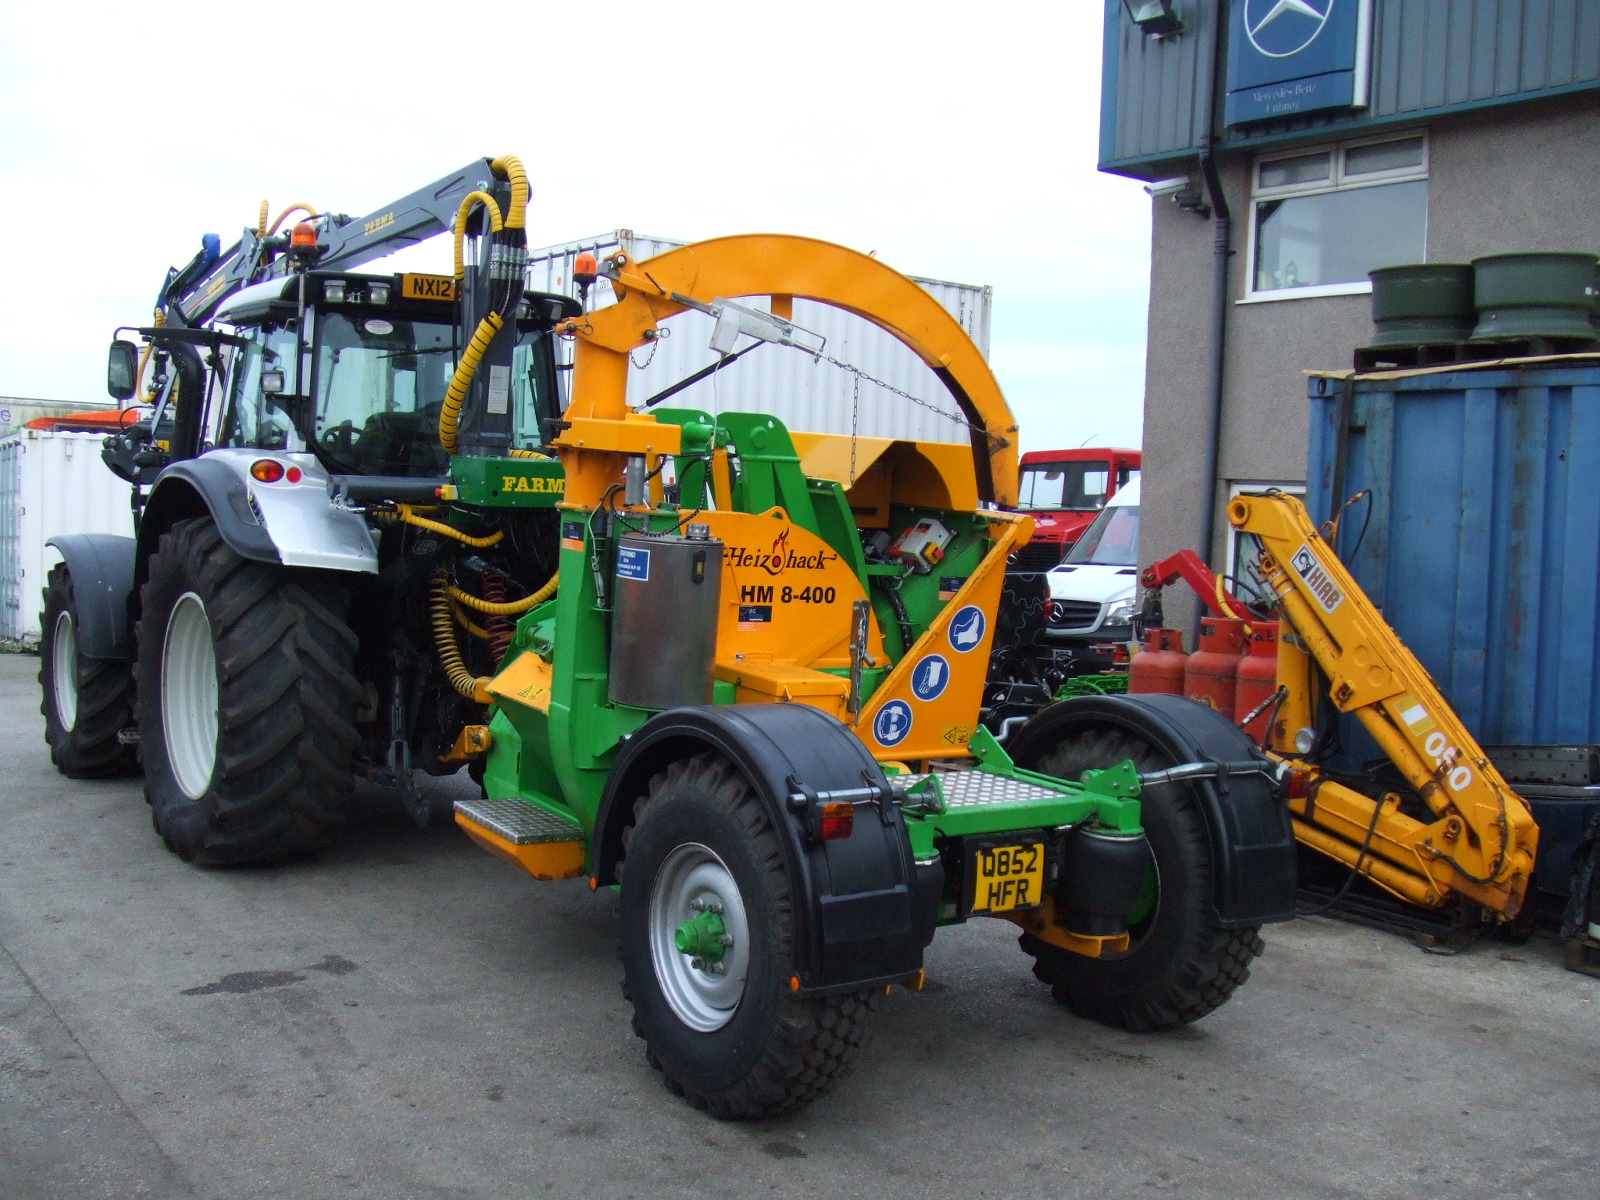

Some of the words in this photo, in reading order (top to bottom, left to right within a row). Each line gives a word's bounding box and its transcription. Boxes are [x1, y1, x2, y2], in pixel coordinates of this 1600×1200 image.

[413, 277, 452, 298] NX12
[741, 584, 774, 603] HM
[780, 585, 837, 604] 8-400
[1307, 567, 1341, 610] HIAB
[982, 847, 1038, 878] Q852
[987, 878, 1030, 909] HFR
